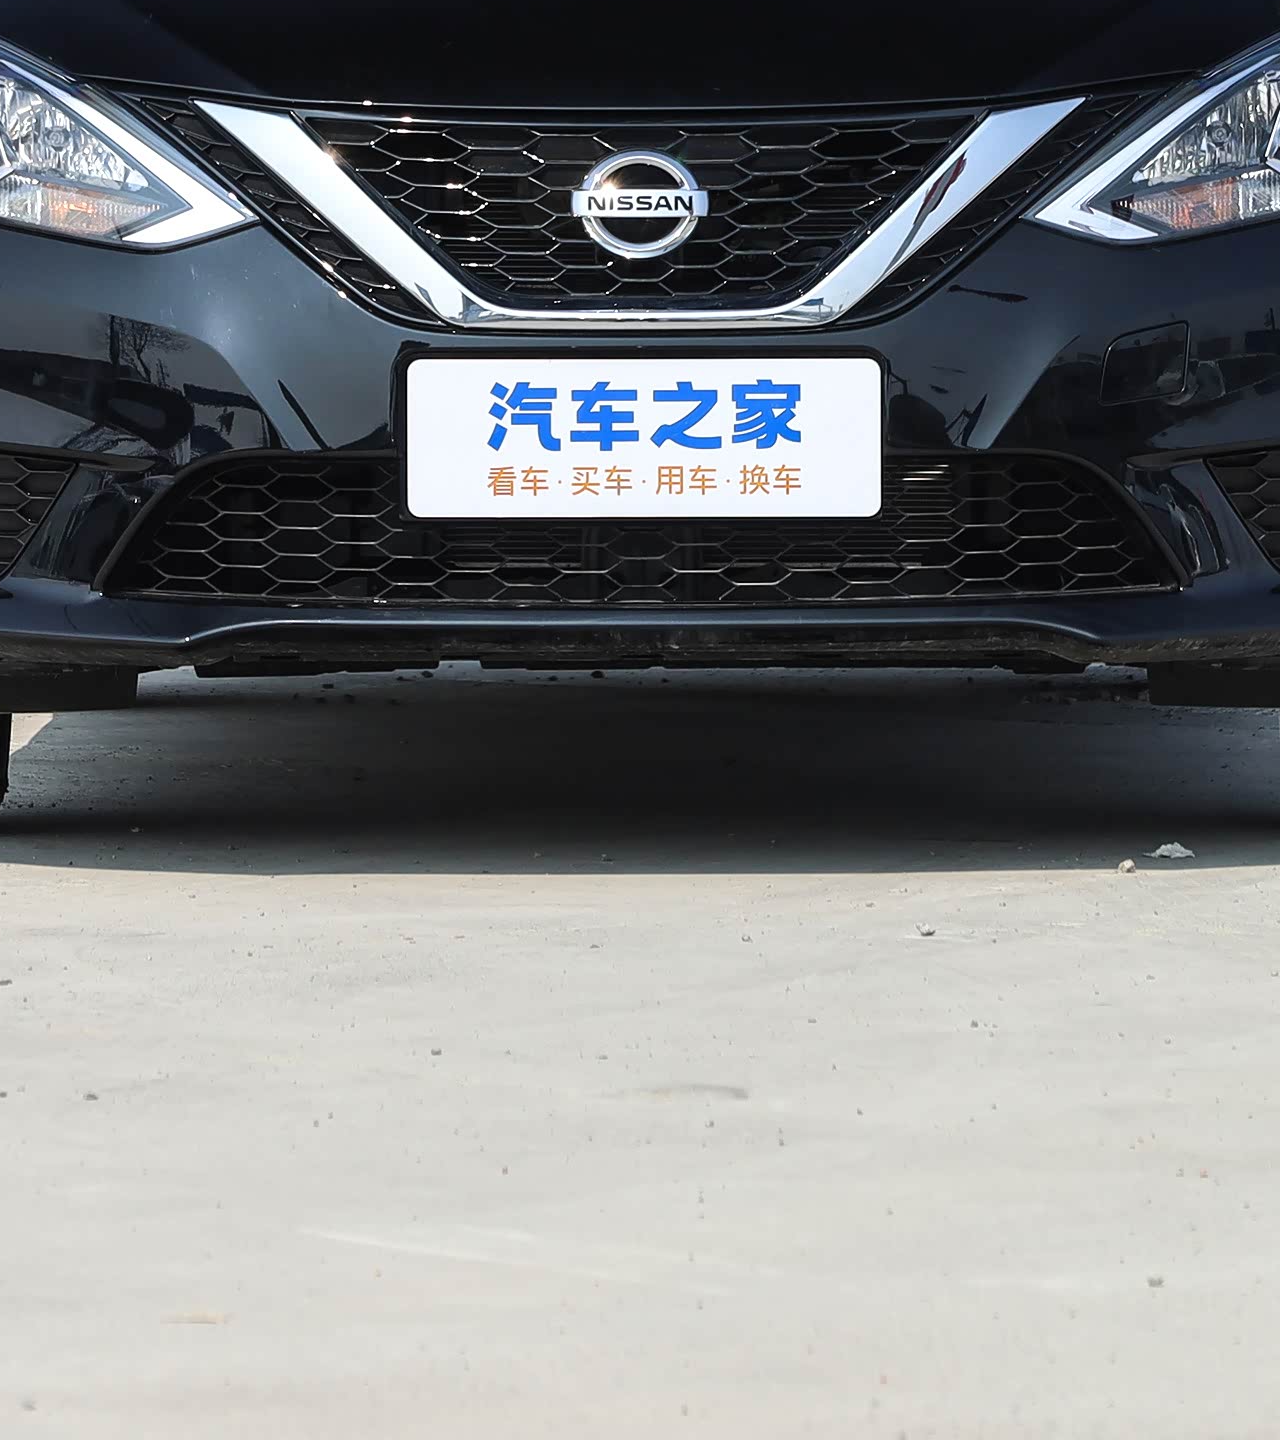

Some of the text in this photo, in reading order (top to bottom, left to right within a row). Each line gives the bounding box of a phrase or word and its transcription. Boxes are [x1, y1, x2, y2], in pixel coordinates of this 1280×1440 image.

[588, 195, 694, 213] NISSAN
[486, 378, 803, 452] 汽车之家
